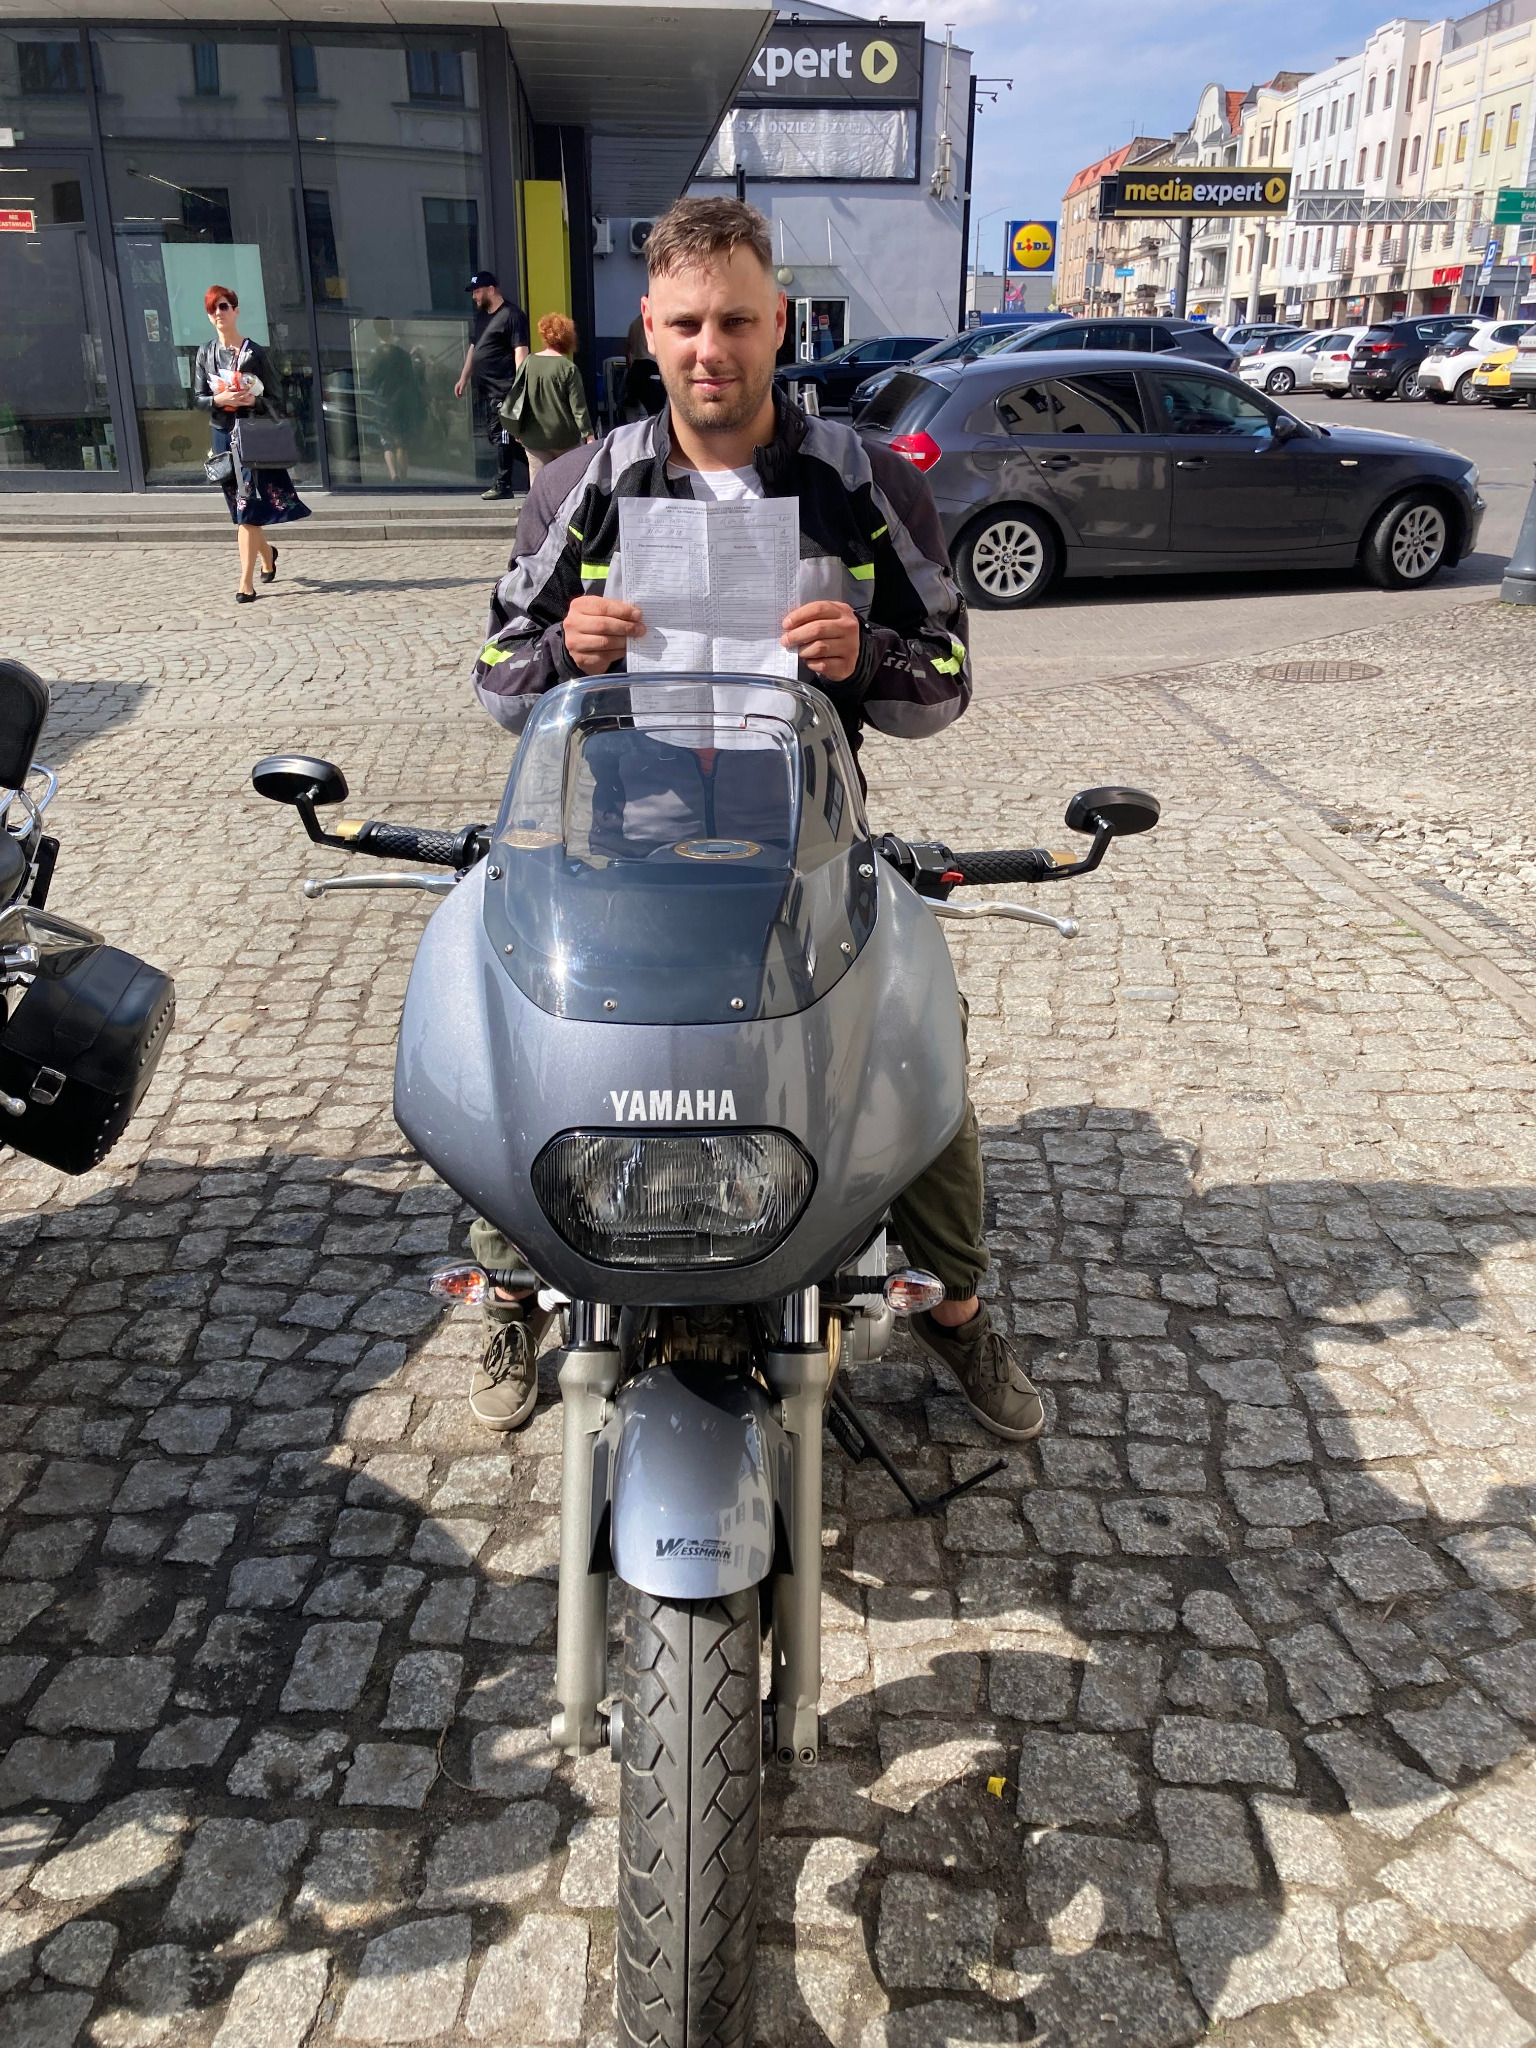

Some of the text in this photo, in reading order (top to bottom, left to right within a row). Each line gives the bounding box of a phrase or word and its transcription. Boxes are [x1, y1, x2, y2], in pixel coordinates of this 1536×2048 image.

[1125, 176, 1263, 206] mediaexpert
[609, 1089, 737, 1121] YAMAHA
[656, 1538, 732, 1559] WESSMANN
